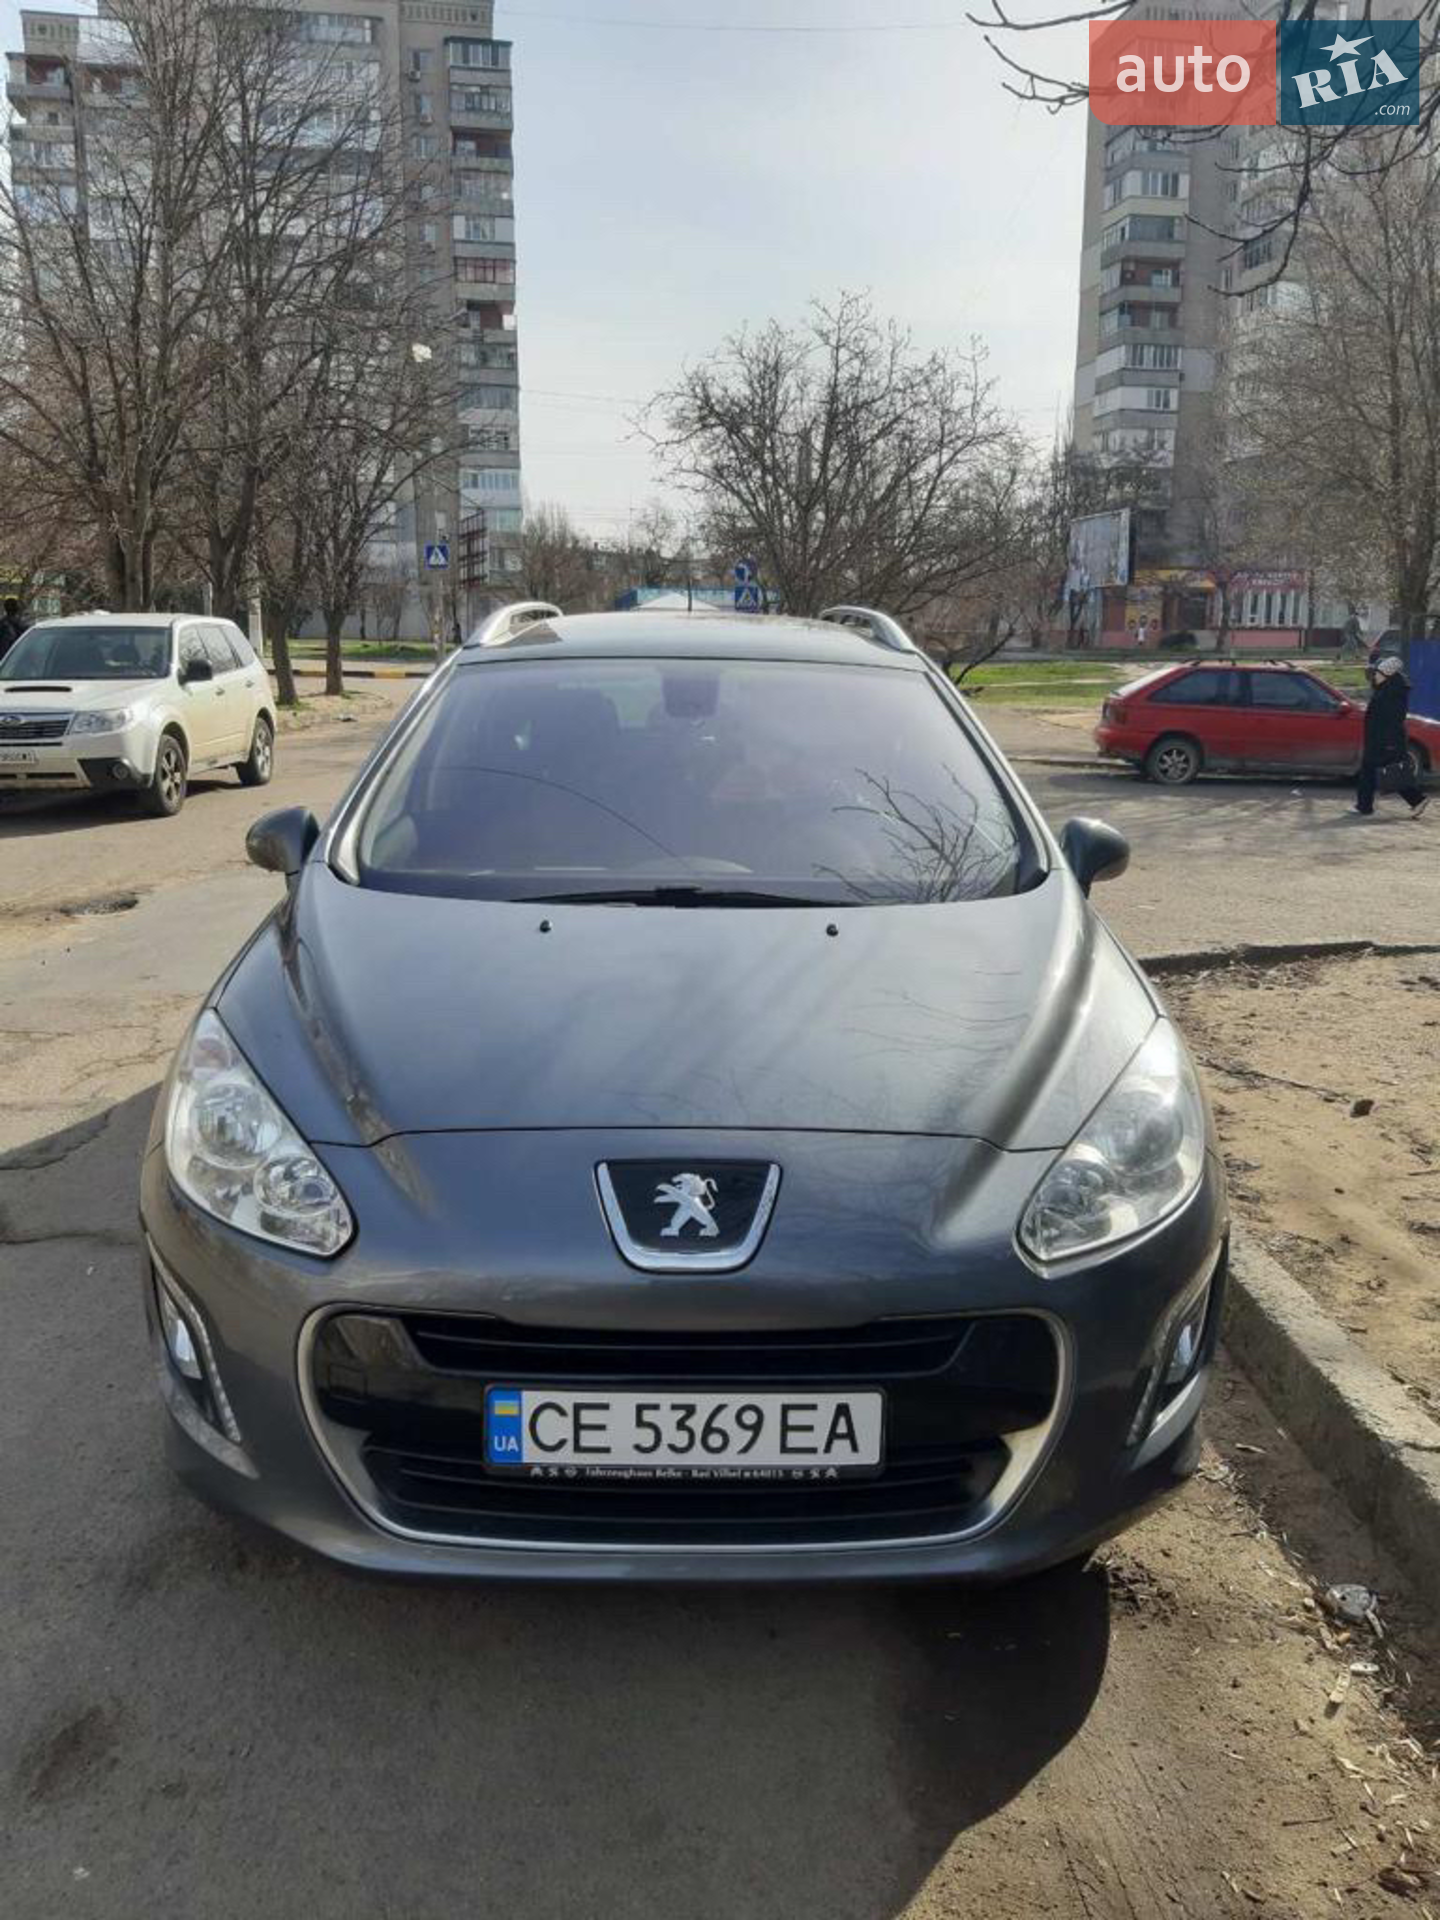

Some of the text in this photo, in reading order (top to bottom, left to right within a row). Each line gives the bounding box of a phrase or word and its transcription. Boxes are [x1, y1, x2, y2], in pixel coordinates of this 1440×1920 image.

[494, 1435, 519, 1452] UA
[528, 1401, 860, 1456] CE 5369 EA
